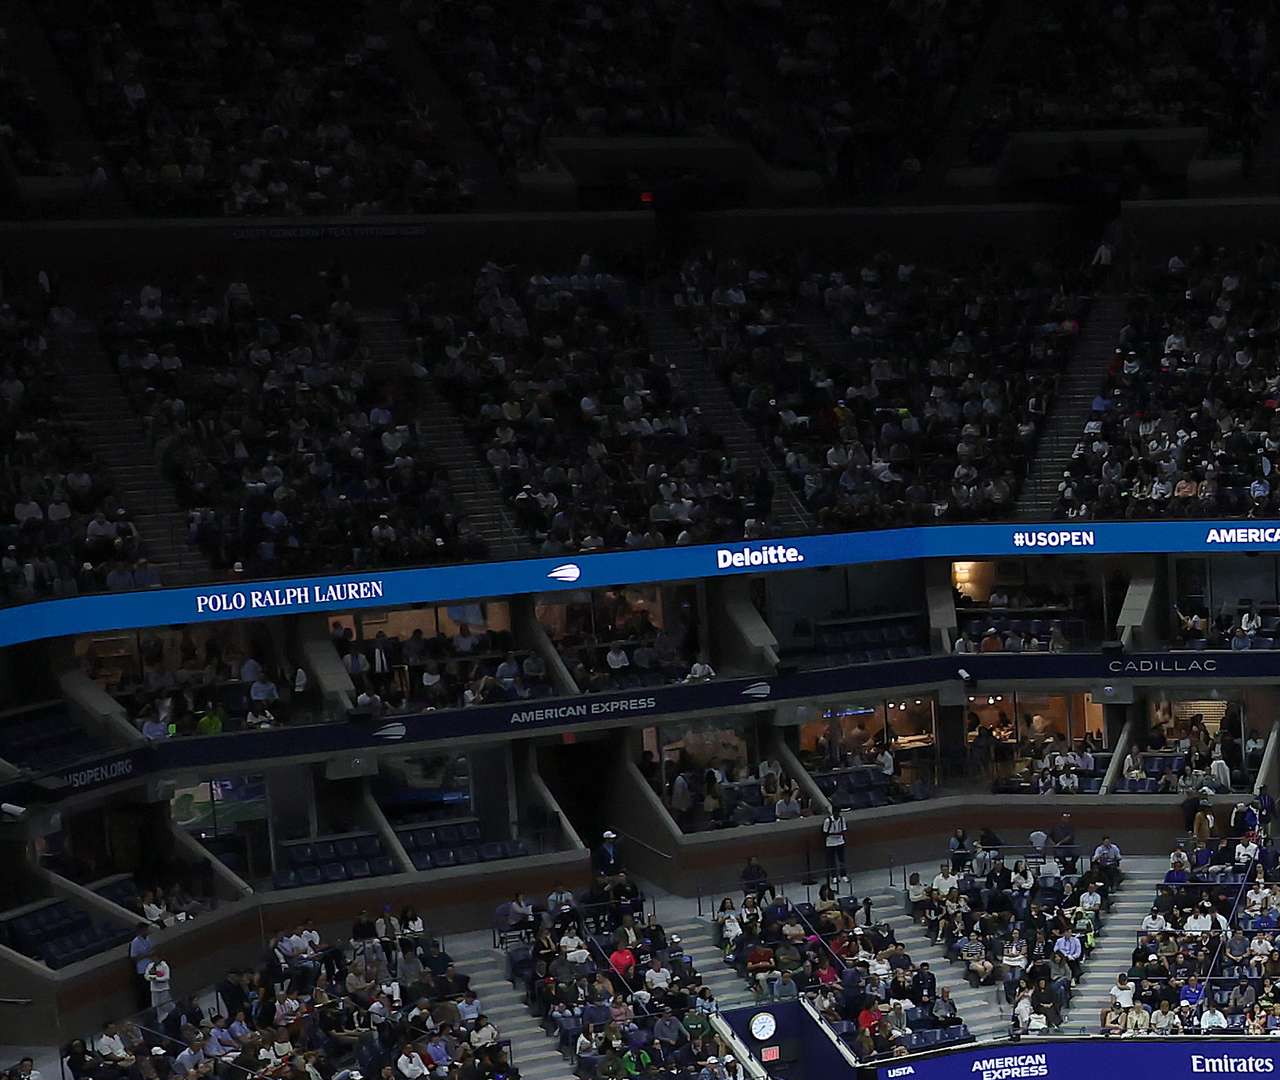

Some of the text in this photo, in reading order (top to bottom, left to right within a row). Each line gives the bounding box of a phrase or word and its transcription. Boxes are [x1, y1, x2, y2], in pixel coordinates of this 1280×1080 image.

[1014, 532, 1094, 547] #USOPEN
[718, 545, 804, 569] Deloitte.
[196, 580, 383, 613] POLO RALPH LAUREN
[1108, 659, 1217, 672] CADILLAC
[511, 696, 656, 724] AMERICAN EXPRESS
[888, 1065, 915, 1078] USTA
[972, 1054, 1047, 1073] AMERICAN
[1191, 1054, 1273, 1073] Emirates
